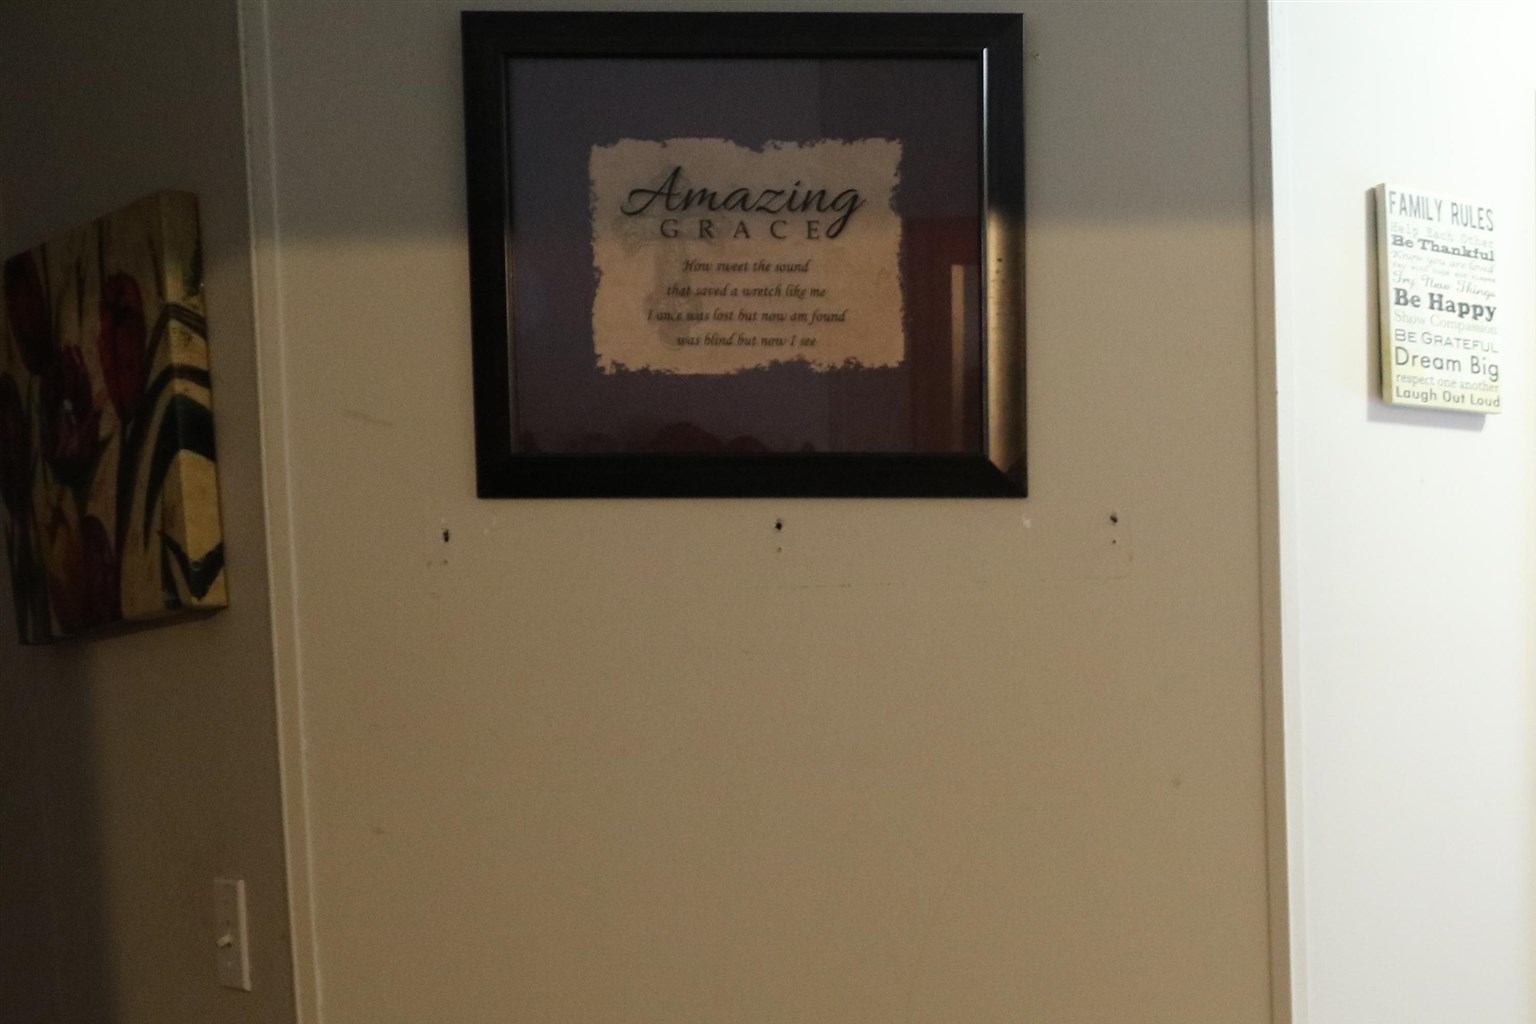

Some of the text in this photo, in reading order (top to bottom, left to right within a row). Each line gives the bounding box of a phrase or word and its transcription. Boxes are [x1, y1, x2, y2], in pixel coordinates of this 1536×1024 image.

[620, 165, 866, 239] Amazing
[1388, 191, 1495, 232] FAMILY RULES
[659, 219, 821, 240] GRACE
[1391, 234, 1495, 262] Be Thankful
[682, 259, 812, 272] How sweet the sound
[666, 283, 826, 300] that saved a wretch like me
[1393, 287, 1497, 322] Be Happy
[647, 307, 849, 326] I once was lost but now am found
[677, 332, 817, 347] was blind but now I see
[1394, 328, 1499, 354] BE GRATEFUL
[1394, 346, 1499, 383] Dream Big
[1396, 374, 1499, 393] respect one another
[1396, 386, 1500, 408] Laugh Out Loud
